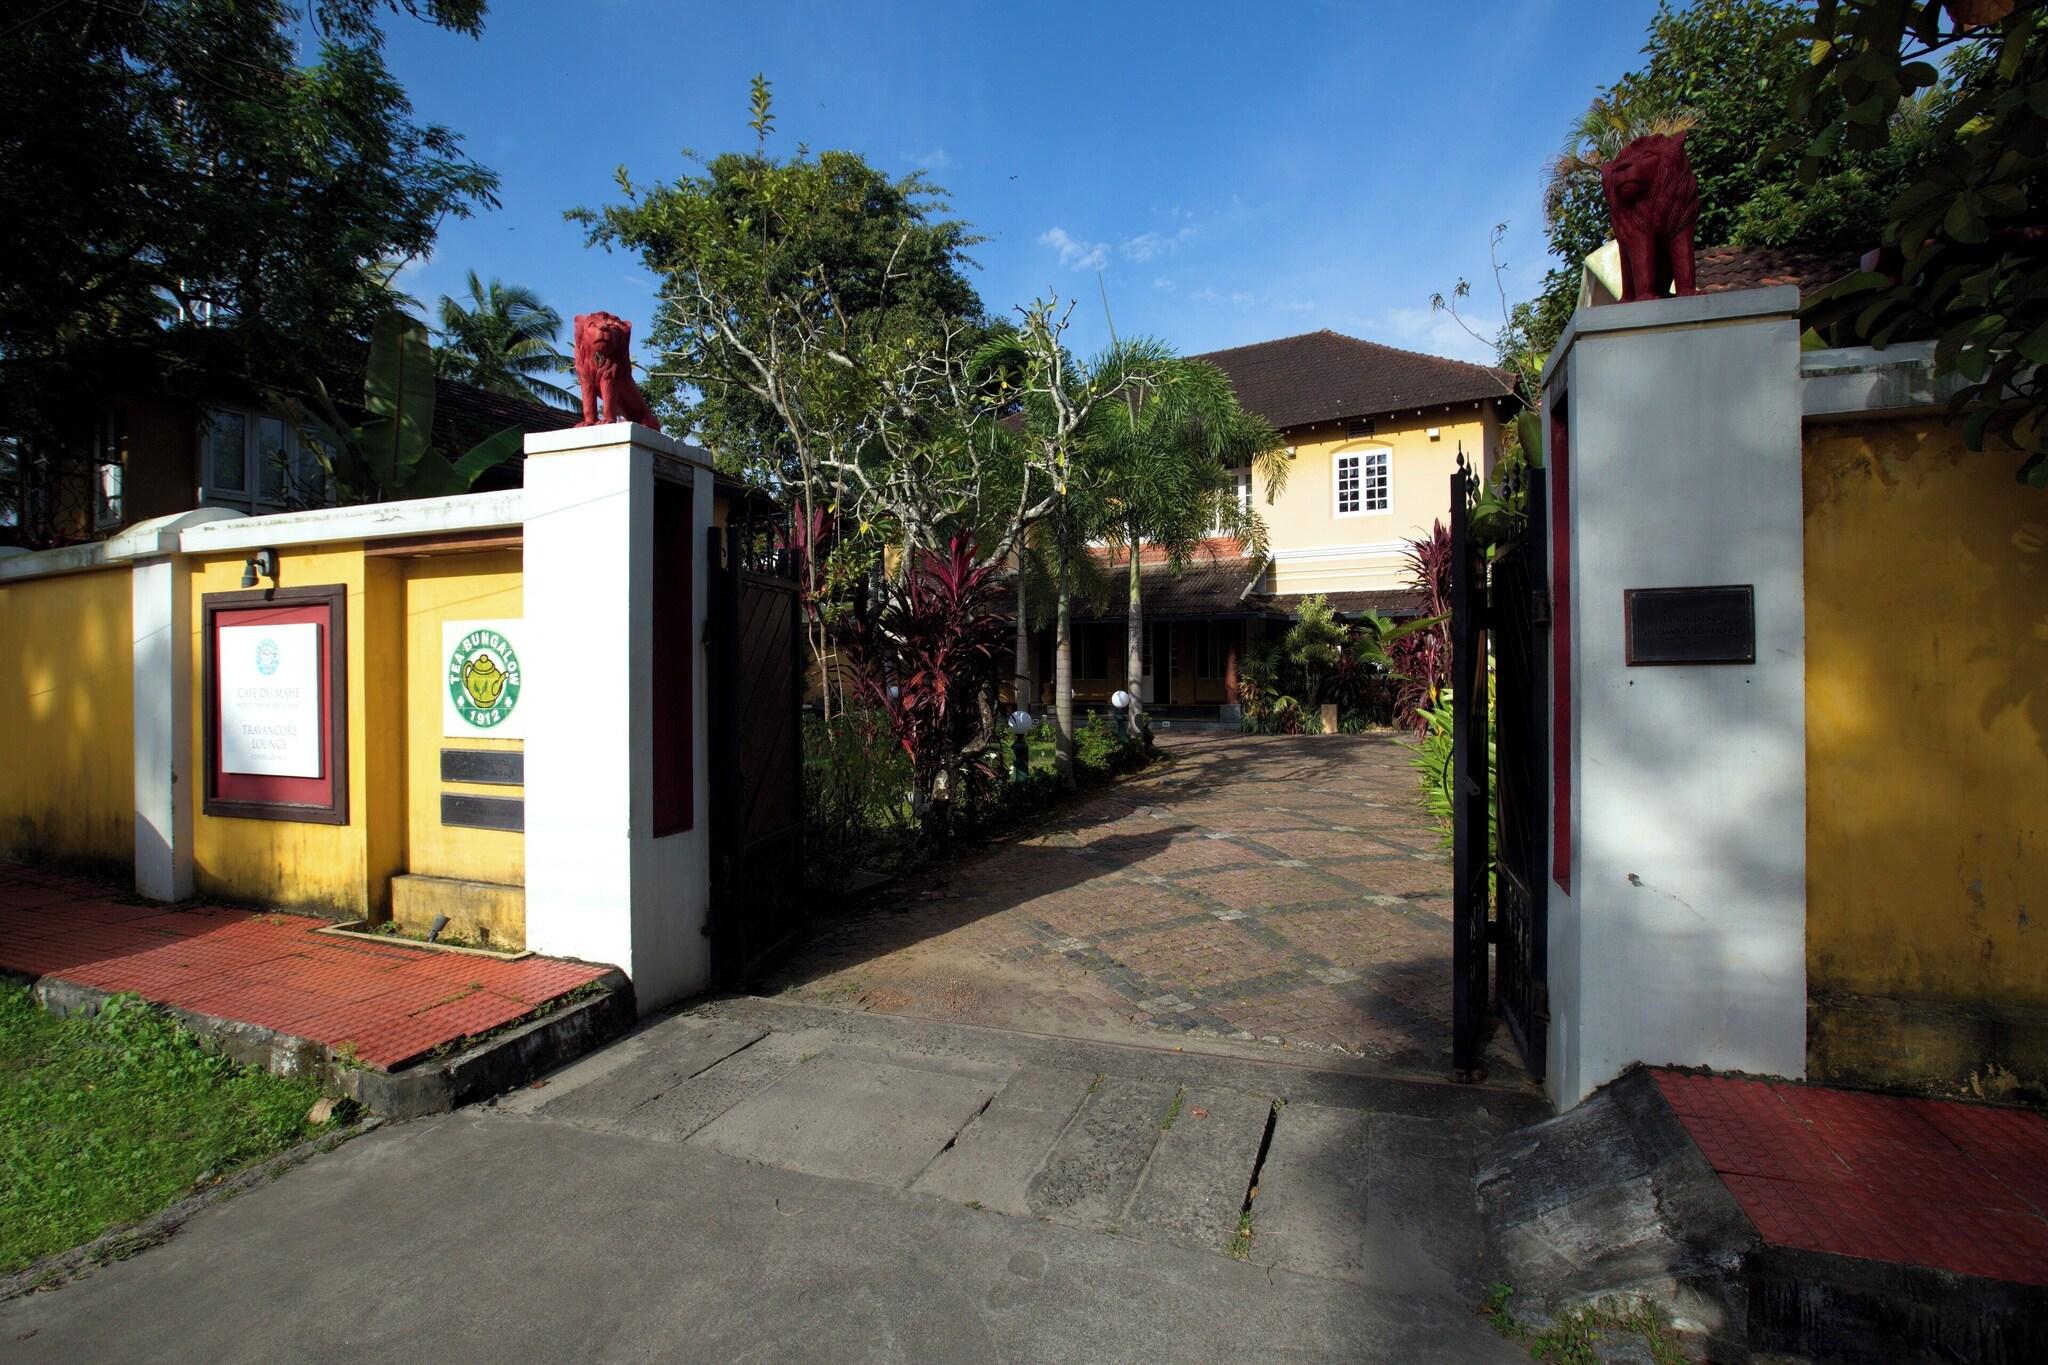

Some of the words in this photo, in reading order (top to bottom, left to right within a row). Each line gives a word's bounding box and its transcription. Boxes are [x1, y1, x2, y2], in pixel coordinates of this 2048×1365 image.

[449, 652, 464, 685] TEA
[463, 631, 520, 686] BUNGALOW
[238, 687, 257, 699] CAFE
[259, 687, 274, 699] DU
[275, 687, 301, 699] MAHE
[470, 709, 501, 725] 1912
[242, 724, 298, 737] TRAVANCORE
[251, 738, 288, 751] LOUNGE
